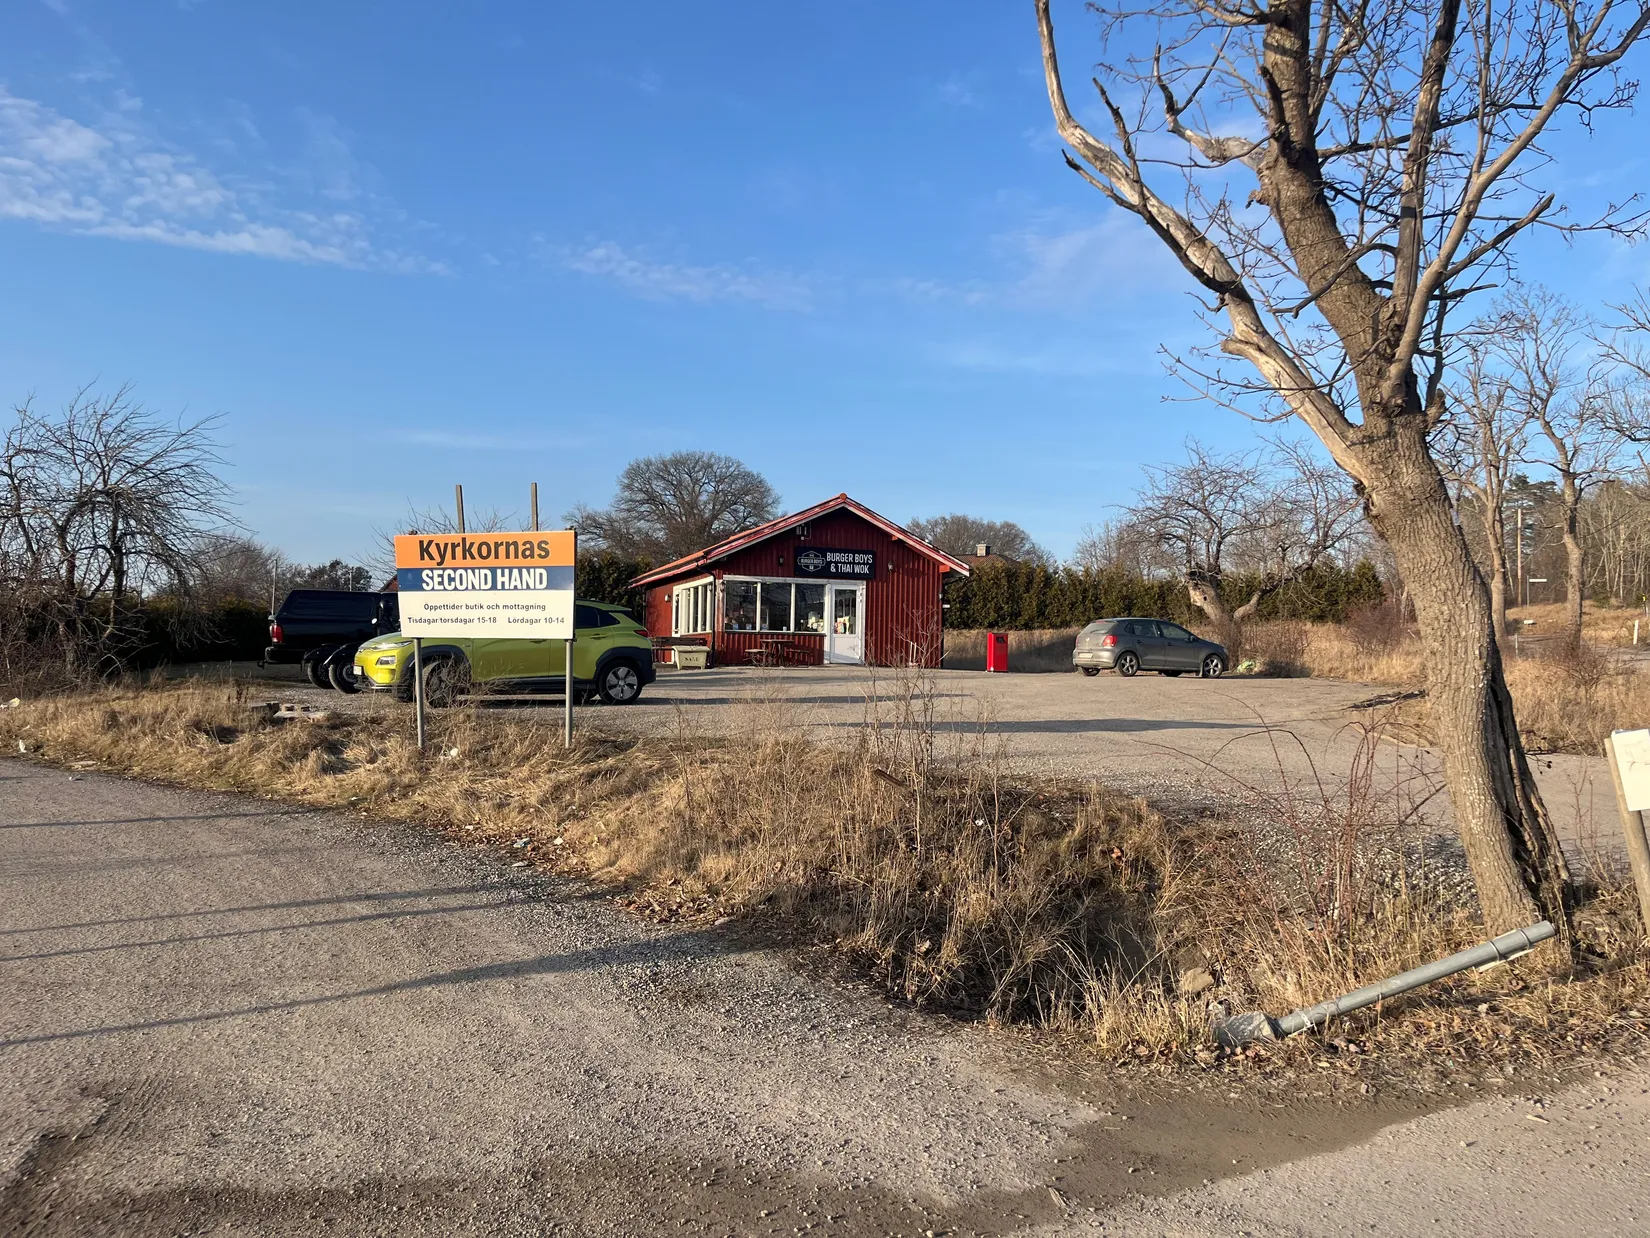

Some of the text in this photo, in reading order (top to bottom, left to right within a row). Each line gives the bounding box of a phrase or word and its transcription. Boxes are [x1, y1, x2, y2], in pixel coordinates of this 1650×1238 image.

[419, 537, 551, 566] Kyrkornas
[826, 552, 872, 563] BURGER BOYS
[830, 563, 869, 574] & THAI WOK
[421, 568, 548, 591] SECOND HAND
[502, 603, 546, 612] mottagning
[477, 616, 497, 624] 15-18
[543, 616, 565, 624] 10-14
